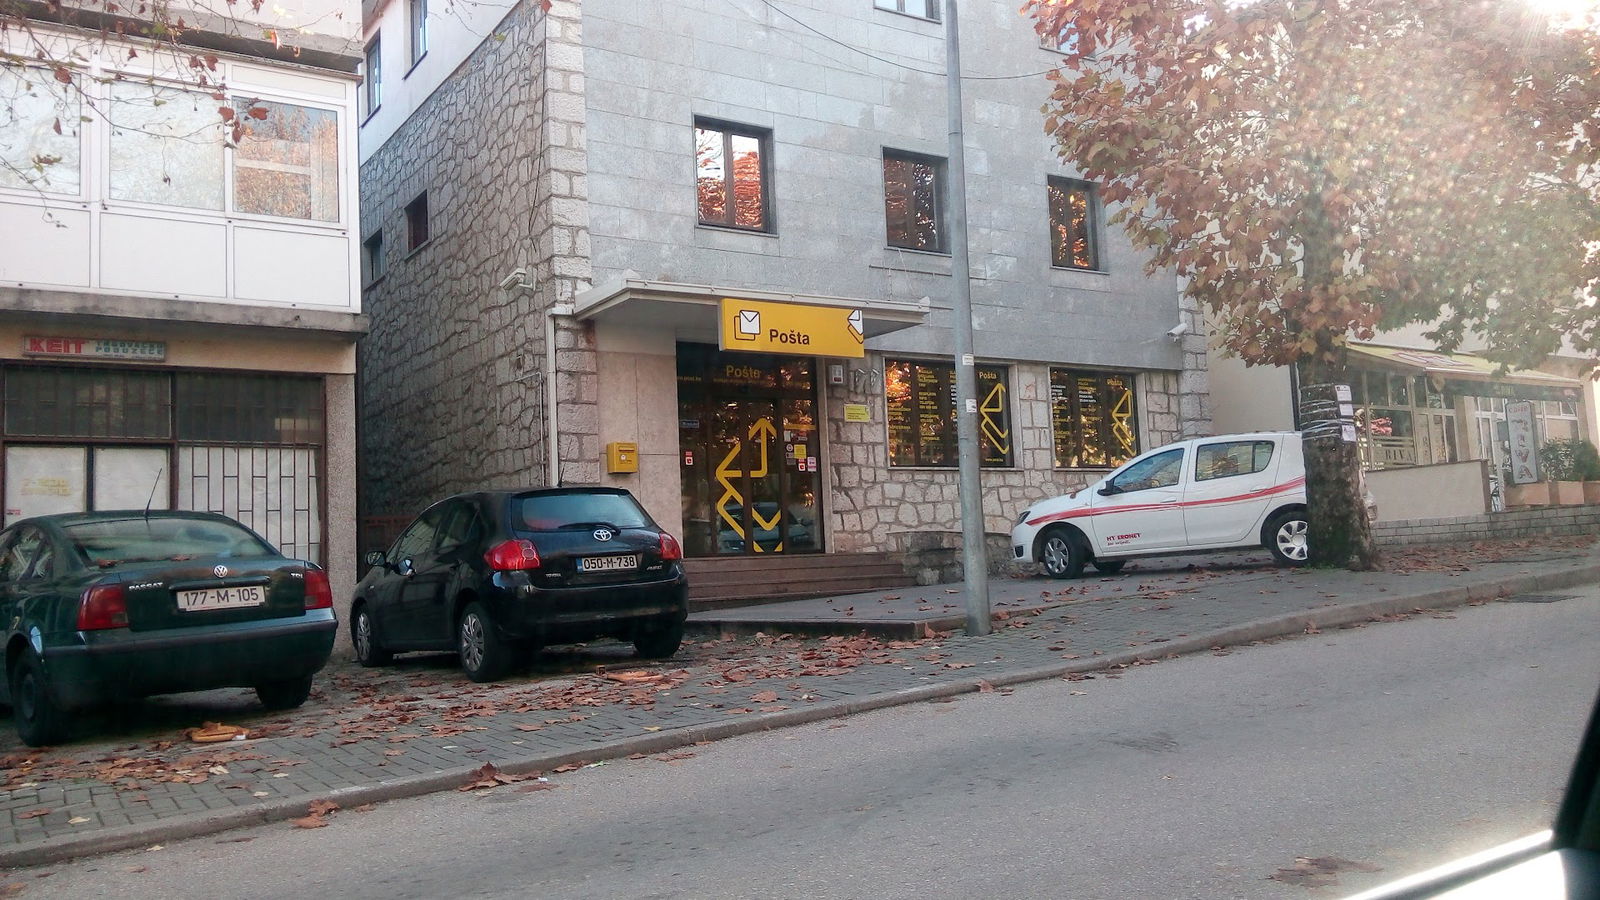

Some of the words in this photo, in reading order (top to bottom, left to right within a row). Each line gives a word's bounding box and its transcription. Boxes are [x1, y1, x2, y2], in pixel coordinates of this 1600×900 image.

[30, 337, 87, 353] KEIT
[769, 329, 810, 345] Pošta
[726, 364, 761, 378] Pošta
[584, 555, 636, 570] 050-M-738
[183, 587, 260, 607] 177-M-105
